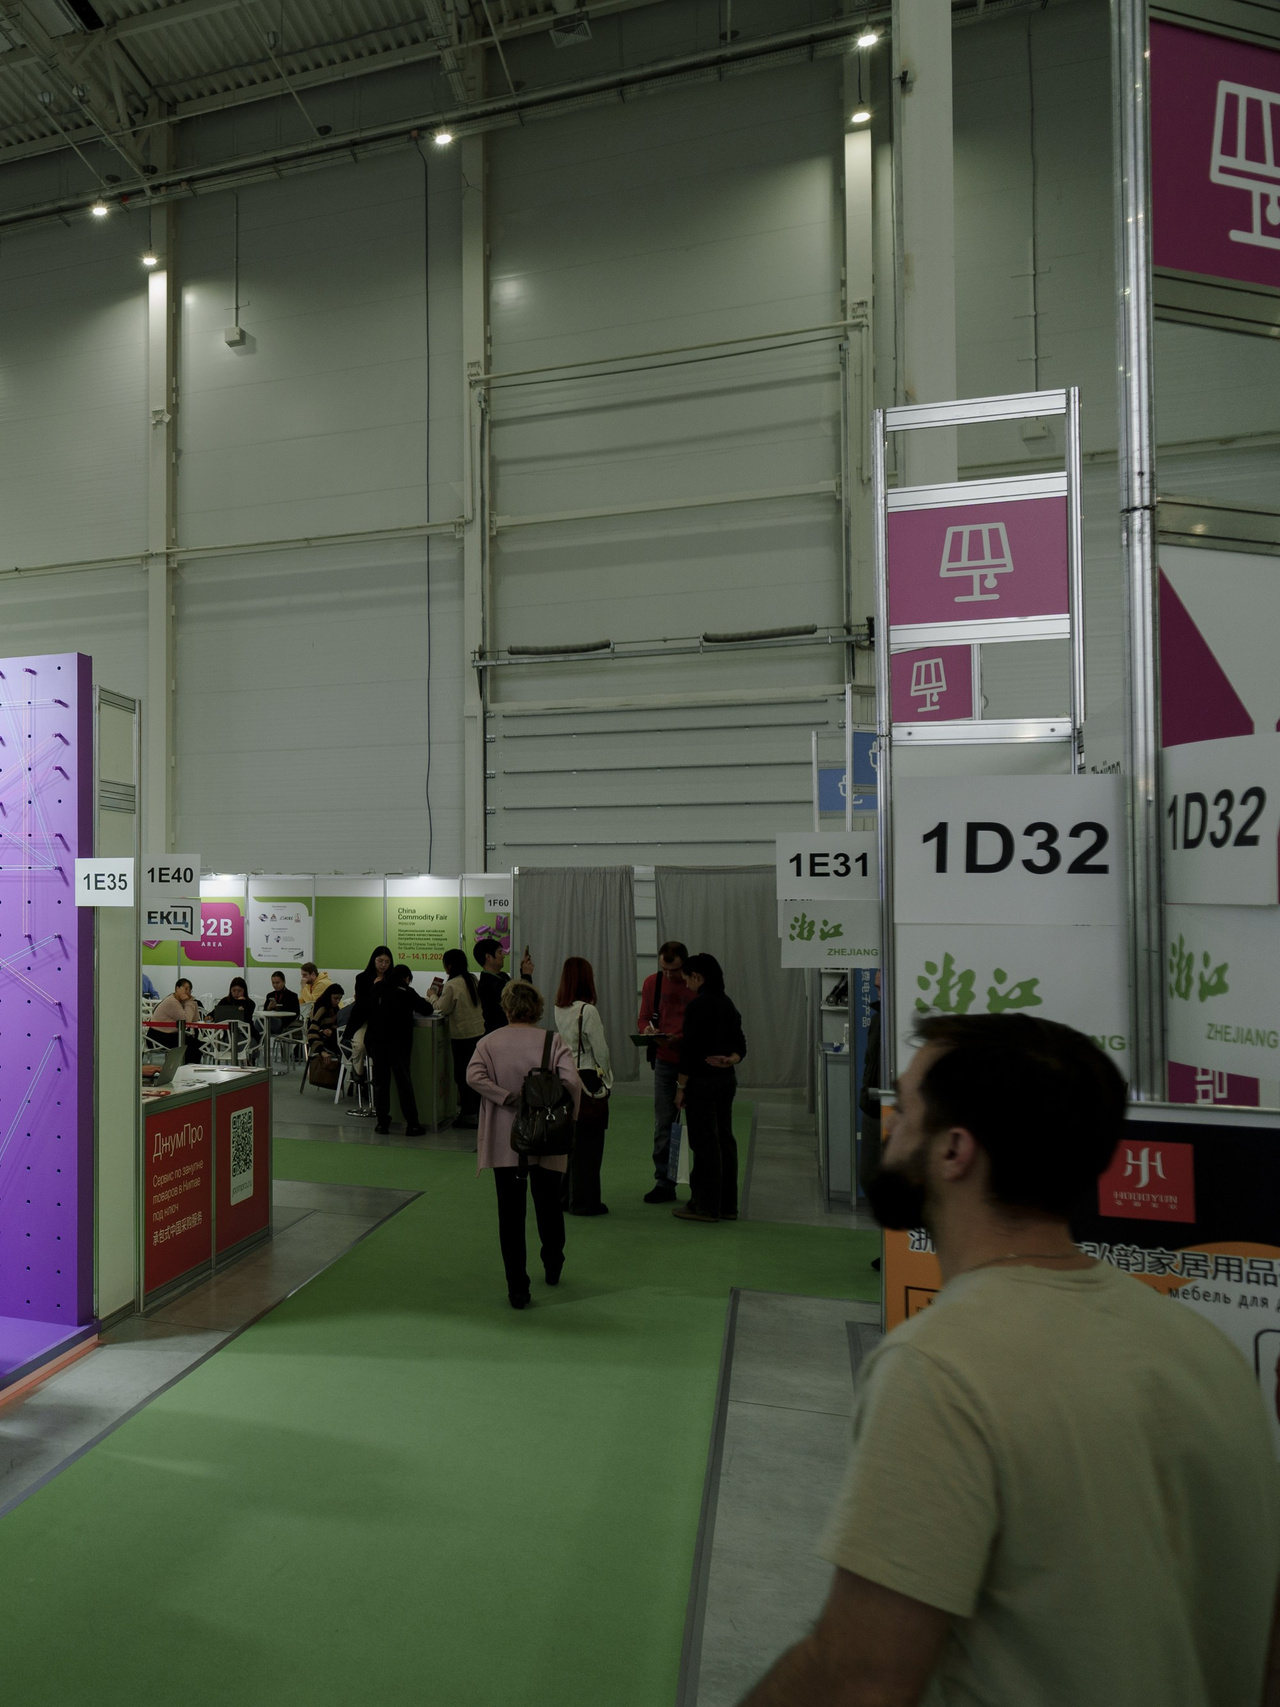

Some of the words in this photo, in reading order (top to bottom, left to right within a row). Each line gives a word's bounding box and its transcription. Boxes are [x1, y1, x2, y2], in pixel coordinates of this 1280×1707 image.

[1167, 785, 1267, 851] 1D32
[922, 821, 1110, 875] 1D32
[147, 867, 194, 883] 1E40
[788, 852, 870, 878] 1E31
[83, 872, 129, 892] 1E35
[488, 899, 509, 907] 1F60
[147, 910, 189, 928] ЕКЦ
[397, 914, 434, 922] Commodity
[789, 912, 844, 942] 浙江
[827, 948, 879, 957] ZHEJIANG
[1167, 933, 1229, 1003] 浙江
[916, 951, 1043, 1016] 浙江
[1206, 1023, 1279, 1050] ZHEJIANG
[152, 1122, 204, 1164] ДжумПро
[152, 1171, 174, 1189] Сервис
[174, 1168, 182, 1180] по
[1169, 1285, 1232, 1304] мебель
[1239, 1294, 1269, 1309] для
